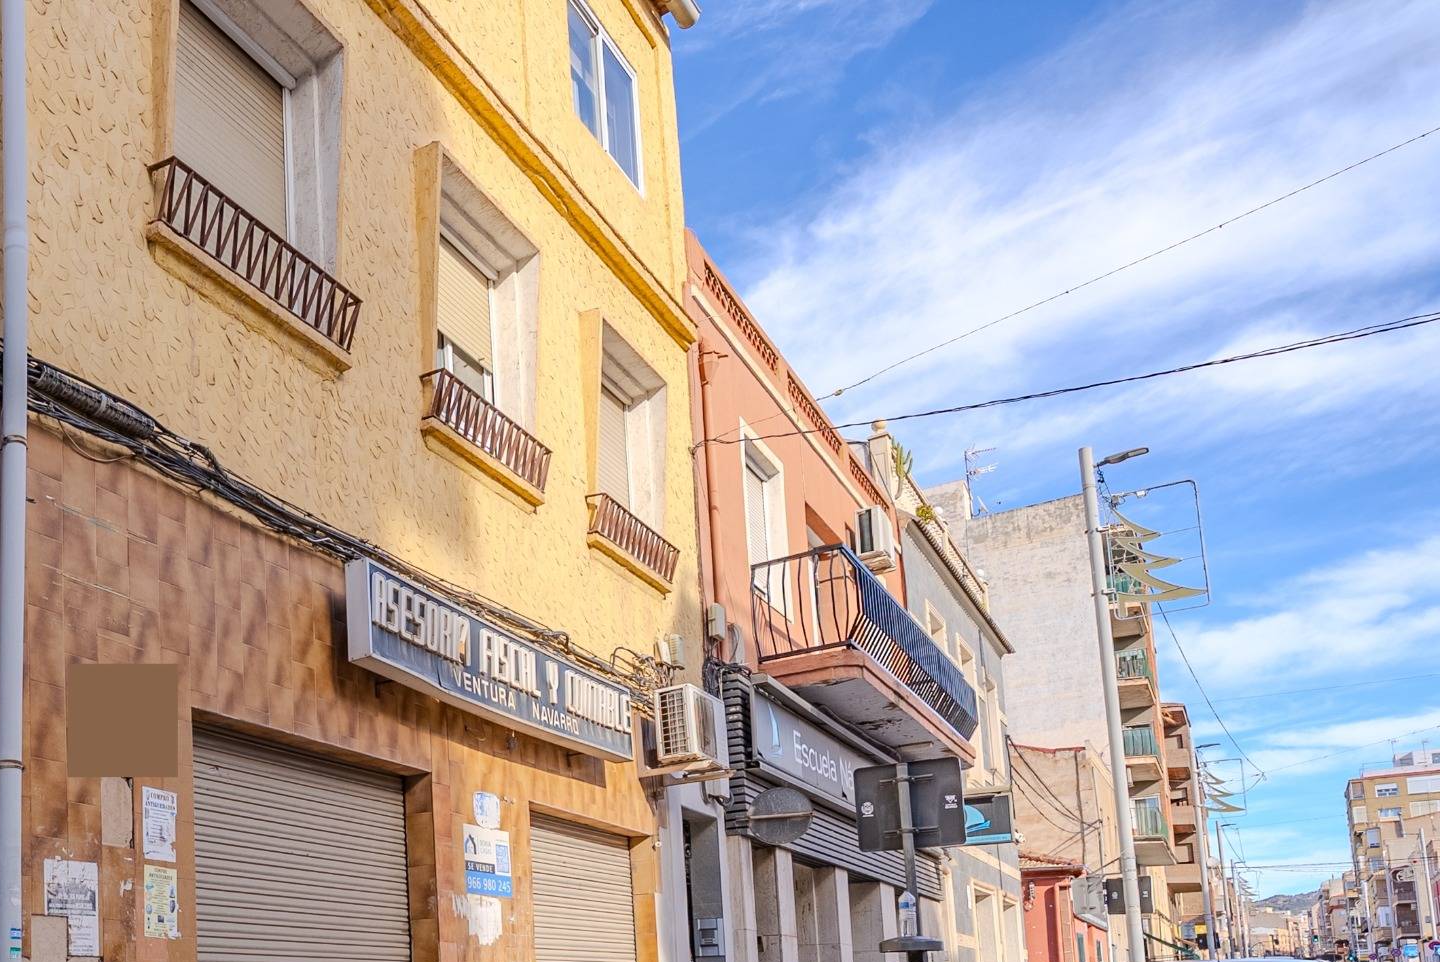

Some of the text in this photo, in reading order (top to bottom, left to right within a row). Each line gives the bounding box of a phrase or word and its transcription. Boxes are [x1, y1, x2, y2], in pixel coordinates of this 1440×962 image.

[372, 571, 471, 666] ASESORIA
[479, 628, 542, 697] FISCAL
[545, 660, 559, 704] Y
[453, 668, 579, 736] VENTURA NAVARRO
[793, 729, 854, 790] Escuela Ná
[467, 861, 494, 874] SE VENDE
[467, 876, 481, 890] 966
[498, 880, 511, 894] 245
